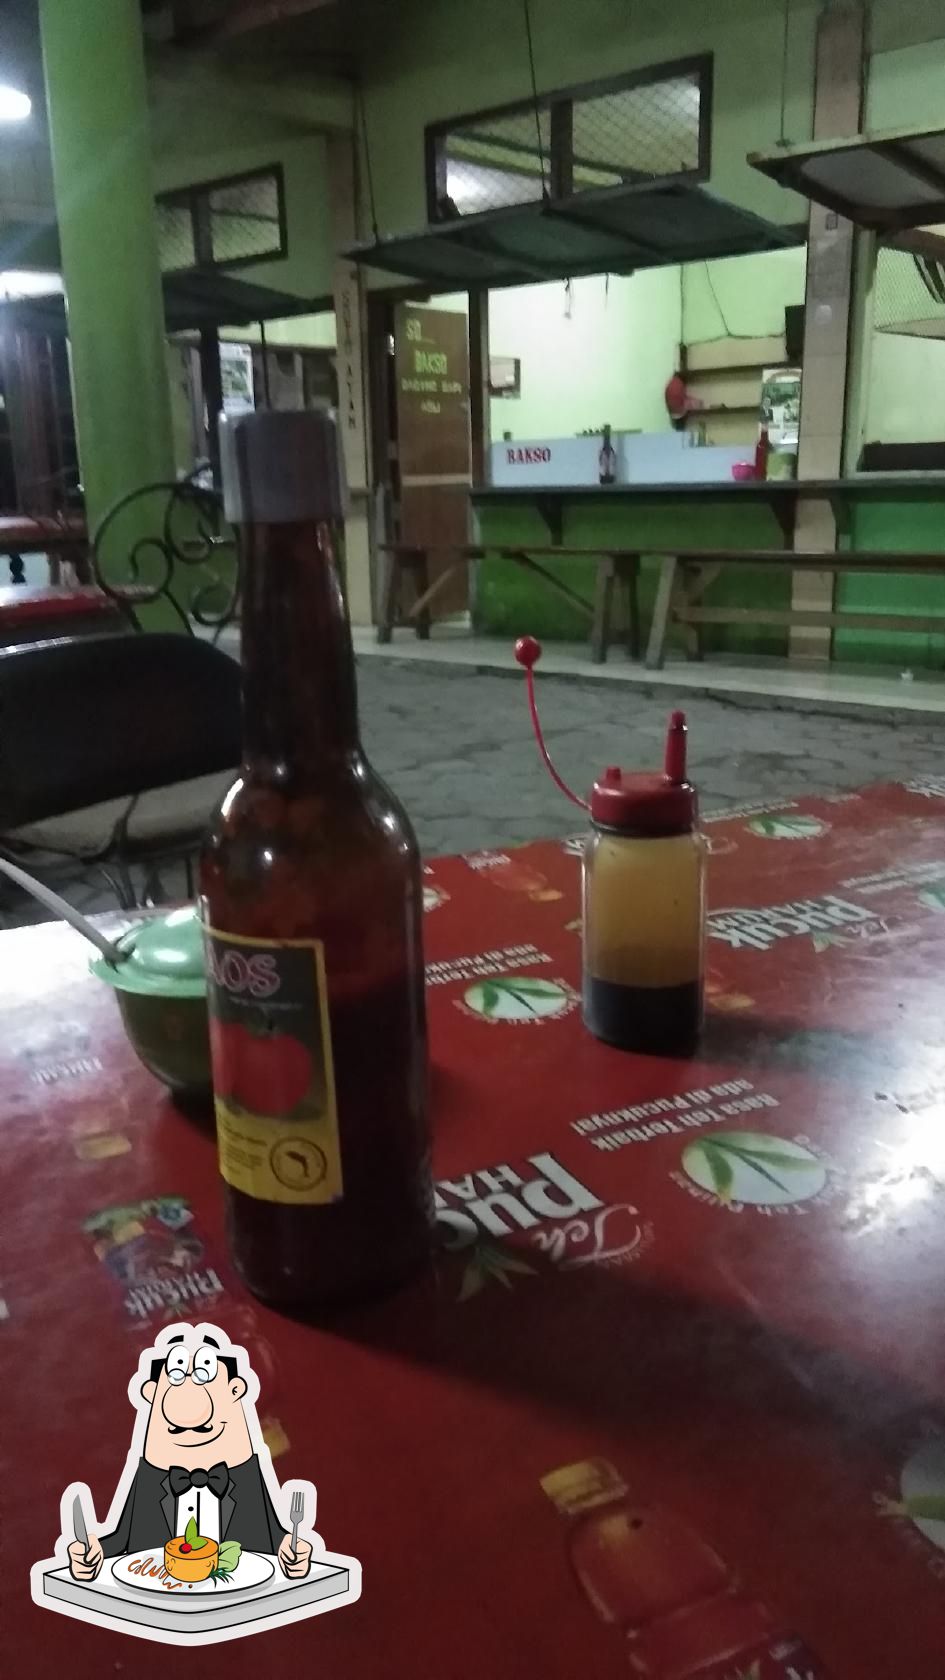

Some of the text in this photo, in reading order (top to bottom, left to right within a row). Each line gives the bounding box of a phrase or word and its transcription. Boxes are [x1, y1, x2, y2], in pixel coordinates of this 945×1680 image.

[415, 349, 448, 376] BAKSO
[506, 447, 551, 465] BAKSO
[684, 1088, 713, 1105] di
[709, 1078, 754, 1096] ada
[590, 1092, 781, 1152] Rasa Teh Terbaik
[530, 1202, 641, 1271] Teh
